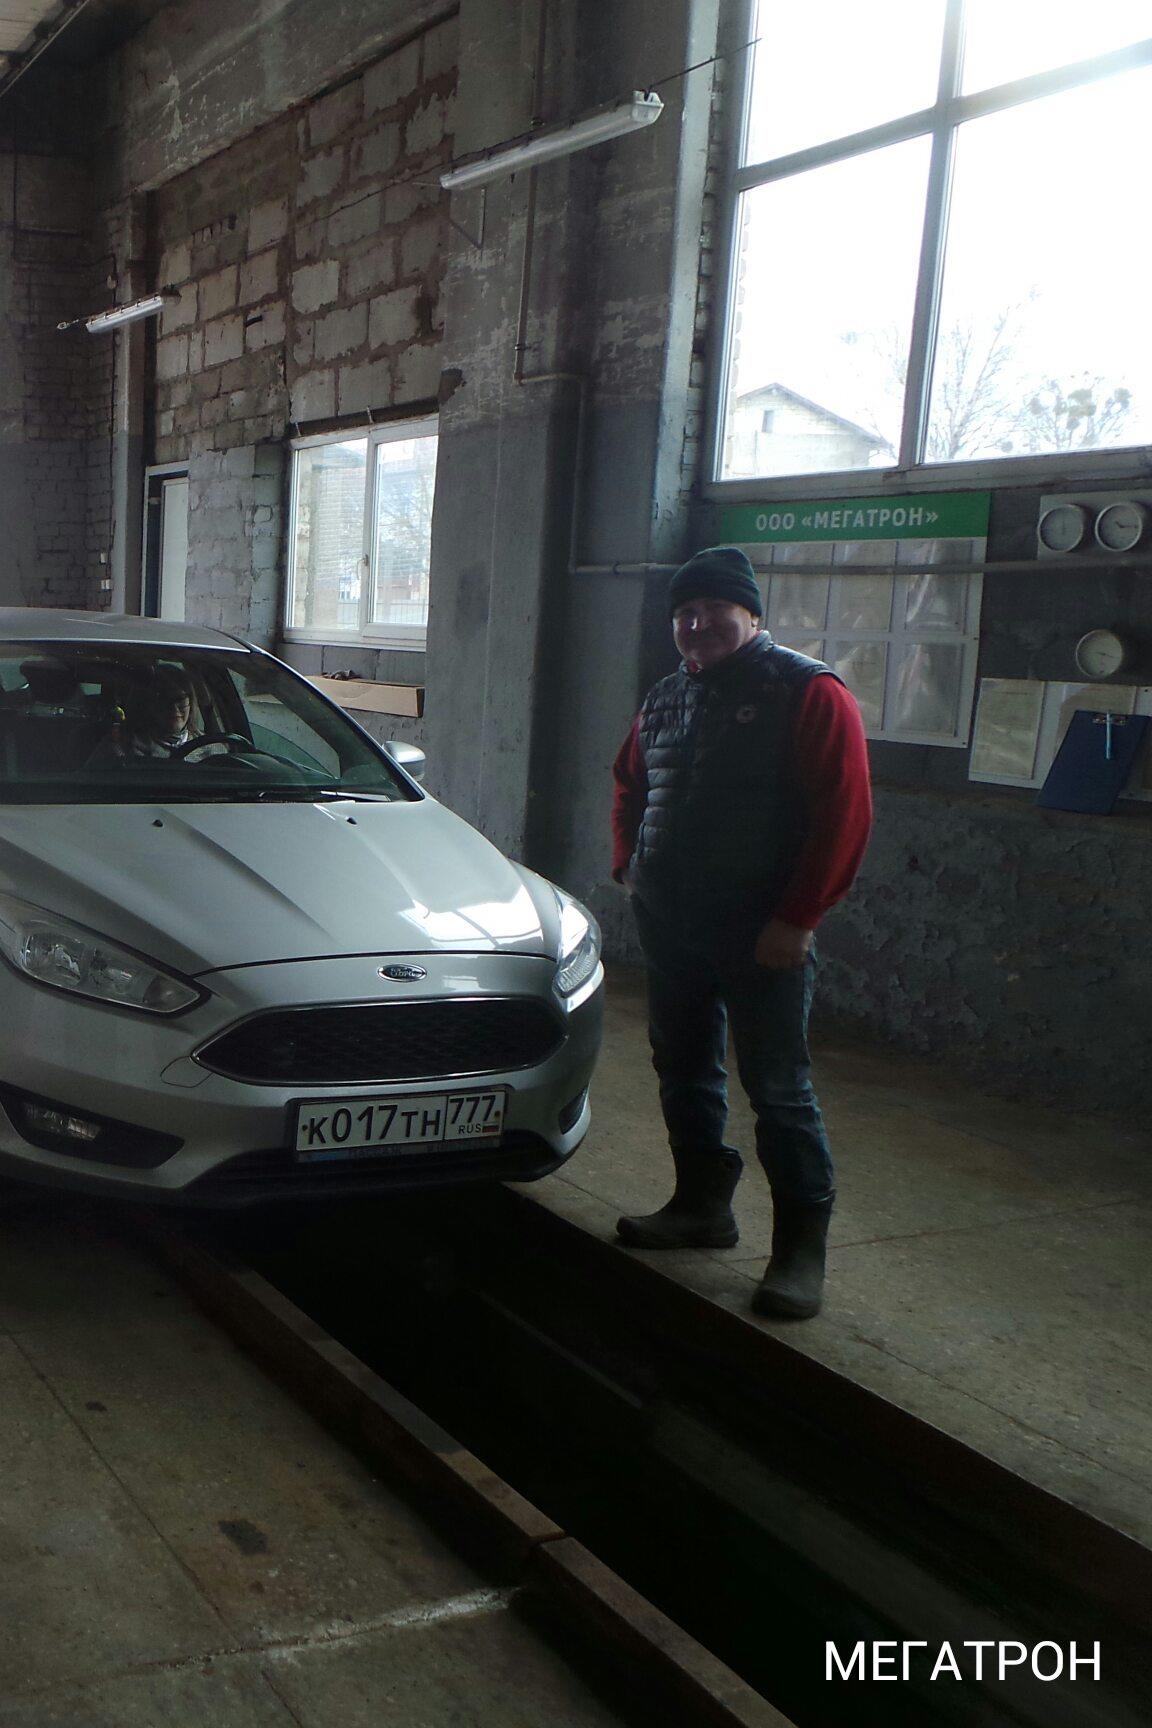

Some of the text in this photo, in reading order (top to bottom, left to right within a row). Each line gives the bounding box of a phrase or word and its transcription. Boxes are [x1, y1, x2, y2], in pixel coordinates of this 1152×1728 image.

[756, 507, 939, 531] ООО «МЕГАТРОН»
[449, 1095, 496, 1125] 777
[458, 1123, 482, 1135] RUS
